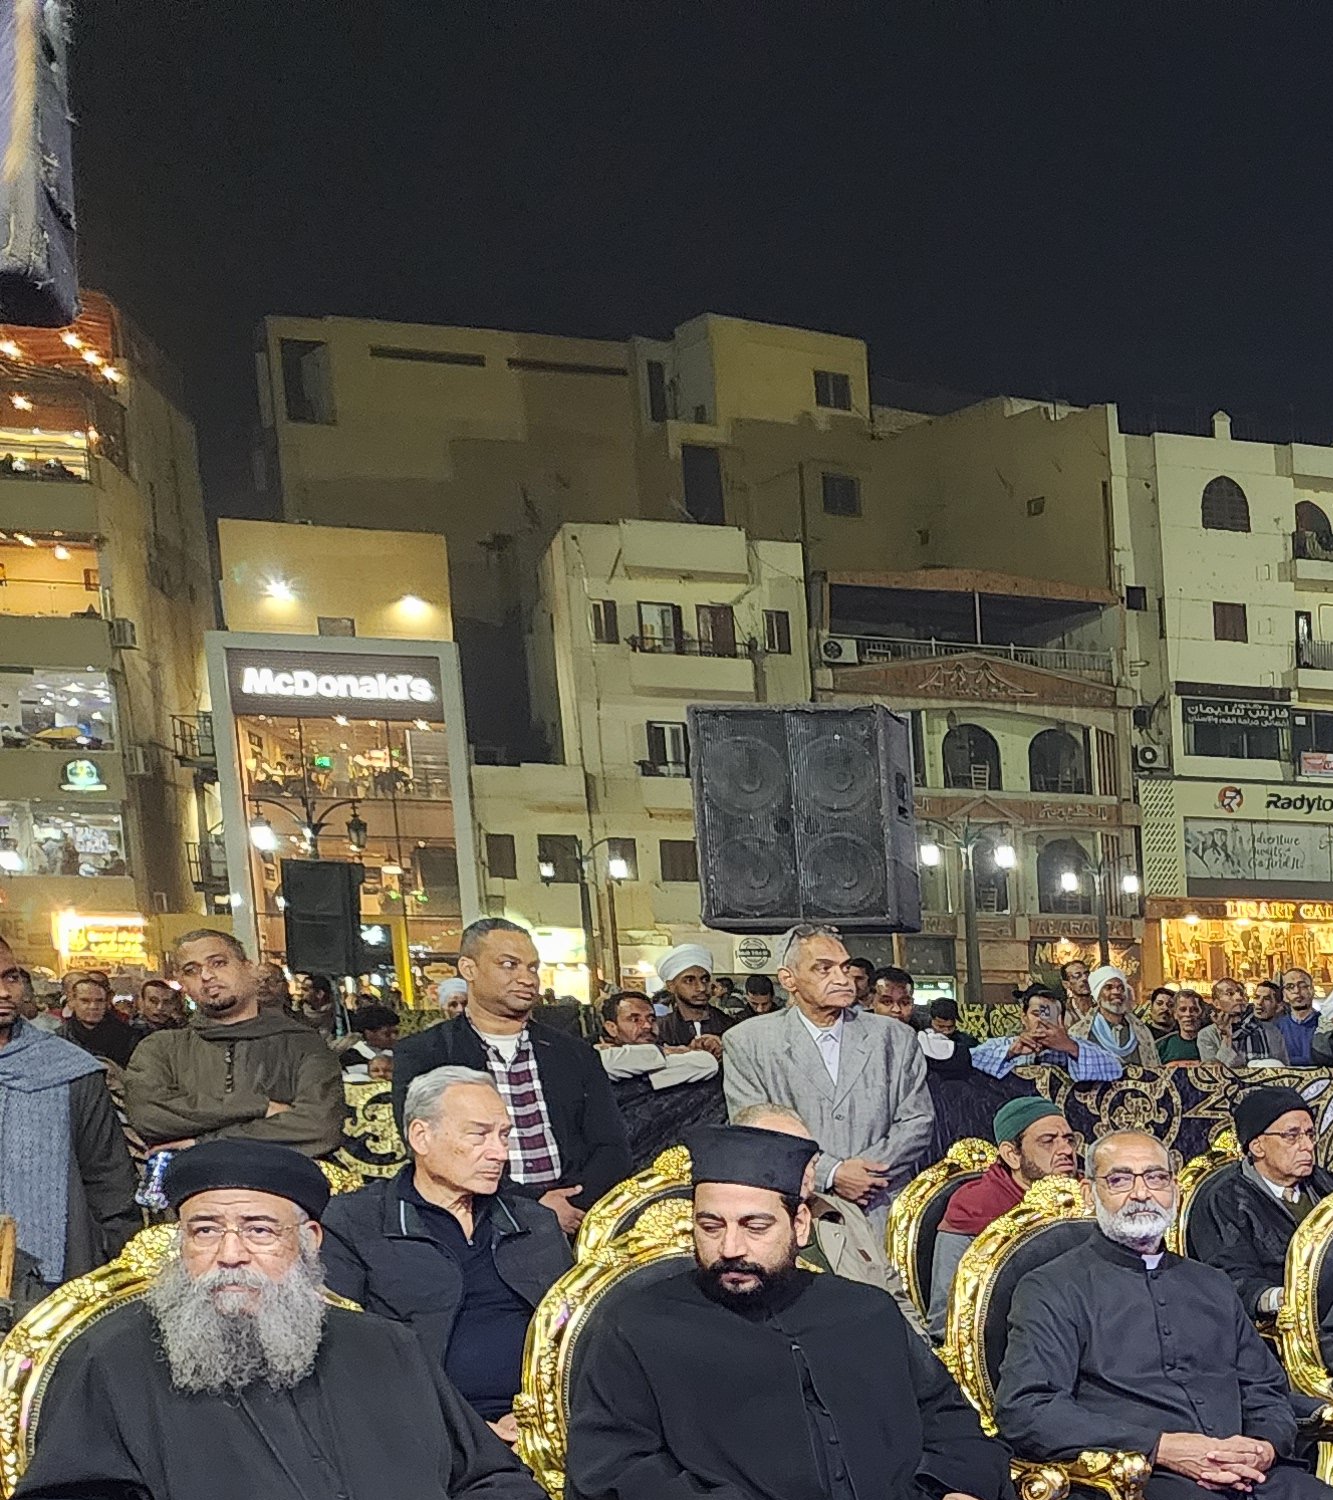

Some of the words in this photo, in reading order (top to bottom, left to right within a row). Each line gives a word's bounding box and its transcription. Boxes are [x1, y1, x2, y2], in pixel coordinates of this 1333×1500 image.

[241, 667, 435, 702] McDonald's
[1187, 703, 1245, 716] سليمان
[1248, 708, 1289, 720] فارس
